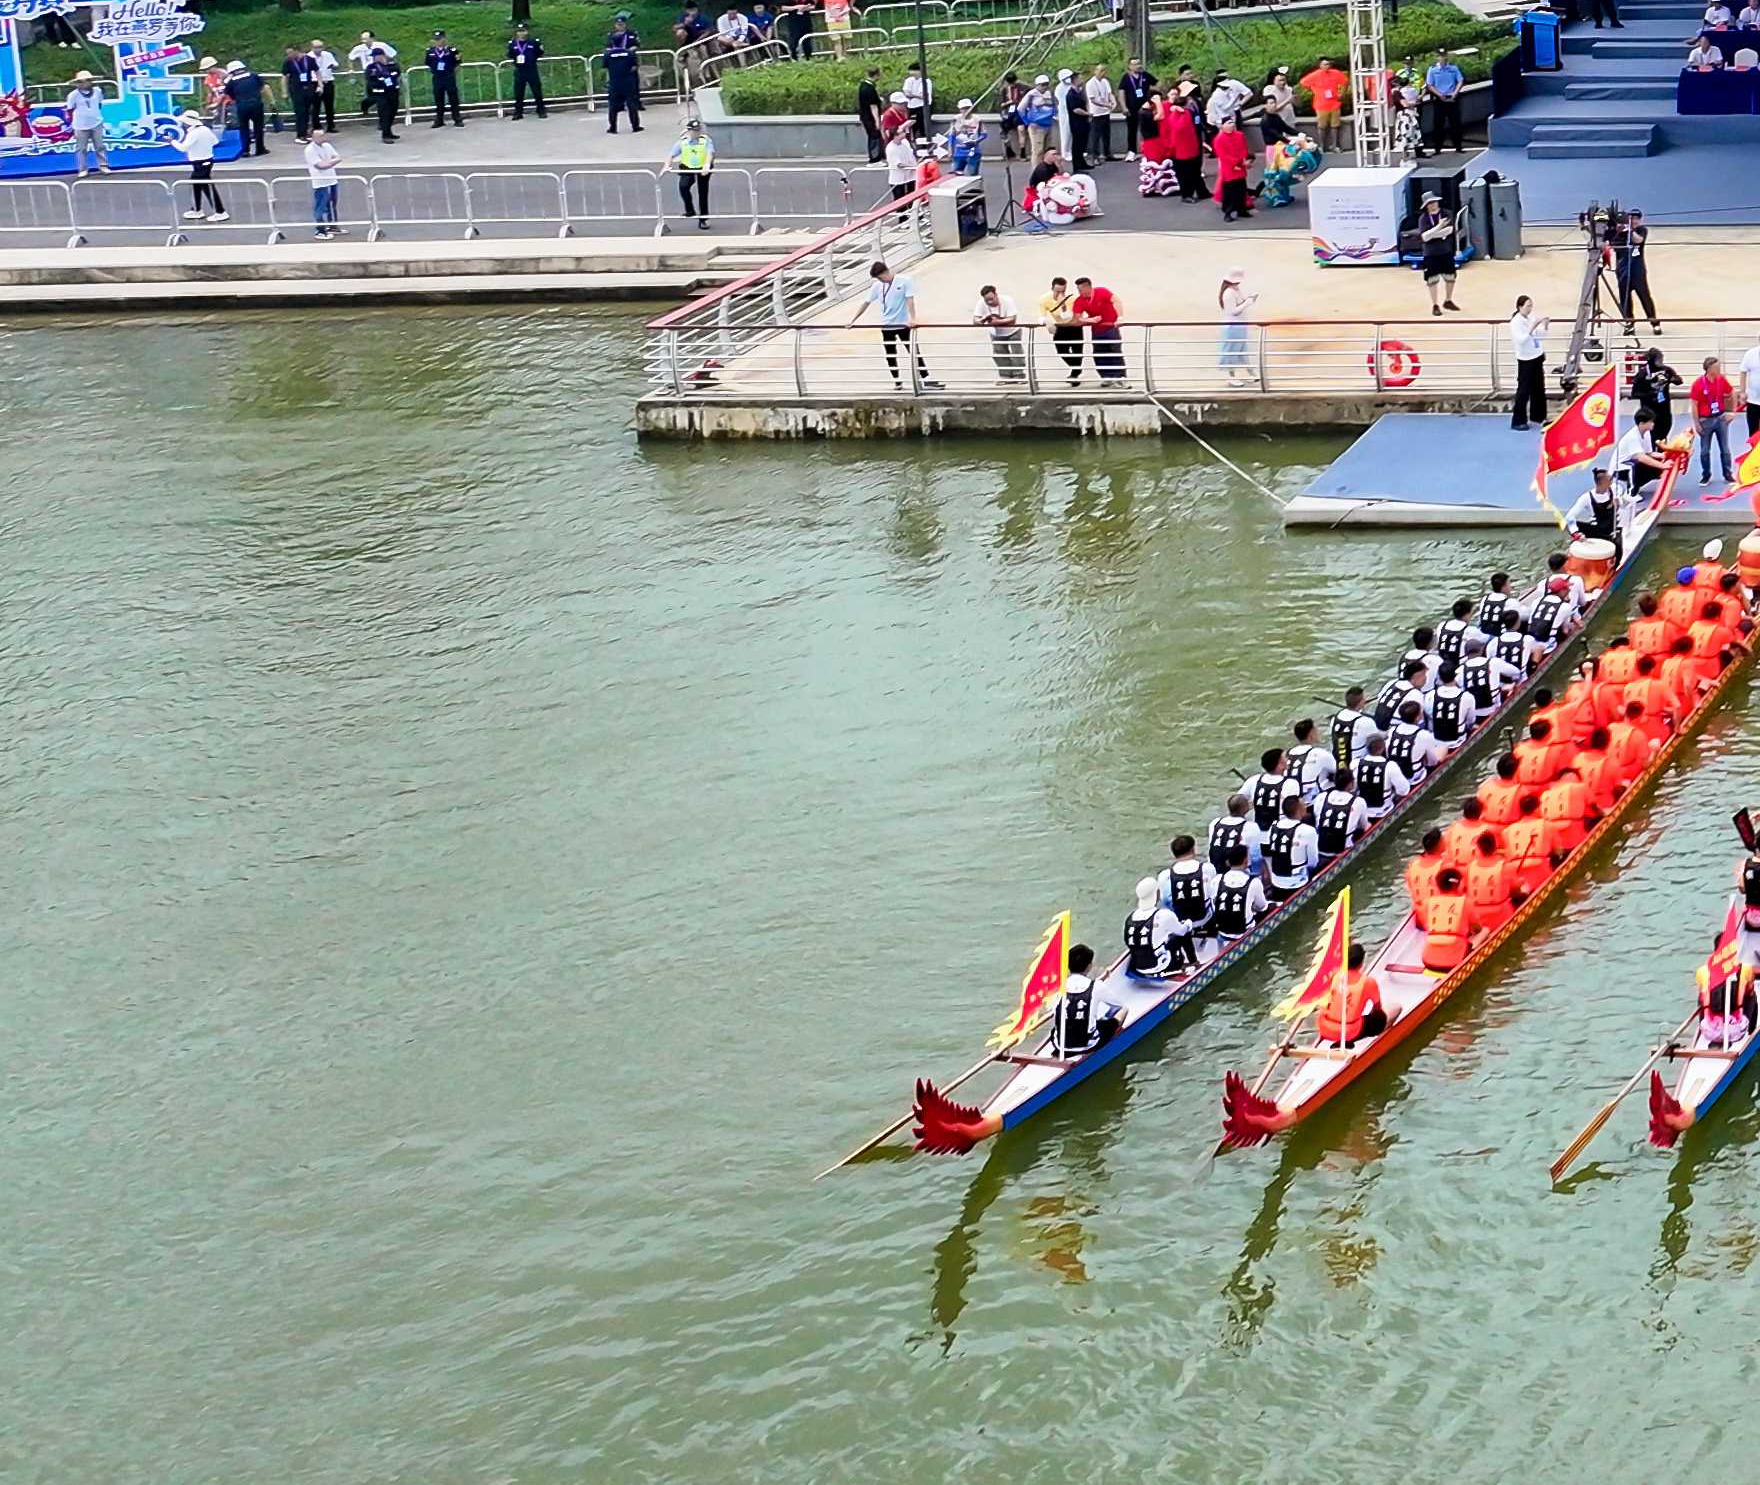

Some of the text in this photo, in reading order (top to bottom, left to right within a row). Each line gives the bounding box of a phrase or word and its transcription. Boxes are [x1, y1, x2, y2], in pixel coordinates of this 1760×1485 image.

[112, 1, 175, 20] Hello!
[96, 16, 201, 39] 我在燕罗等你
